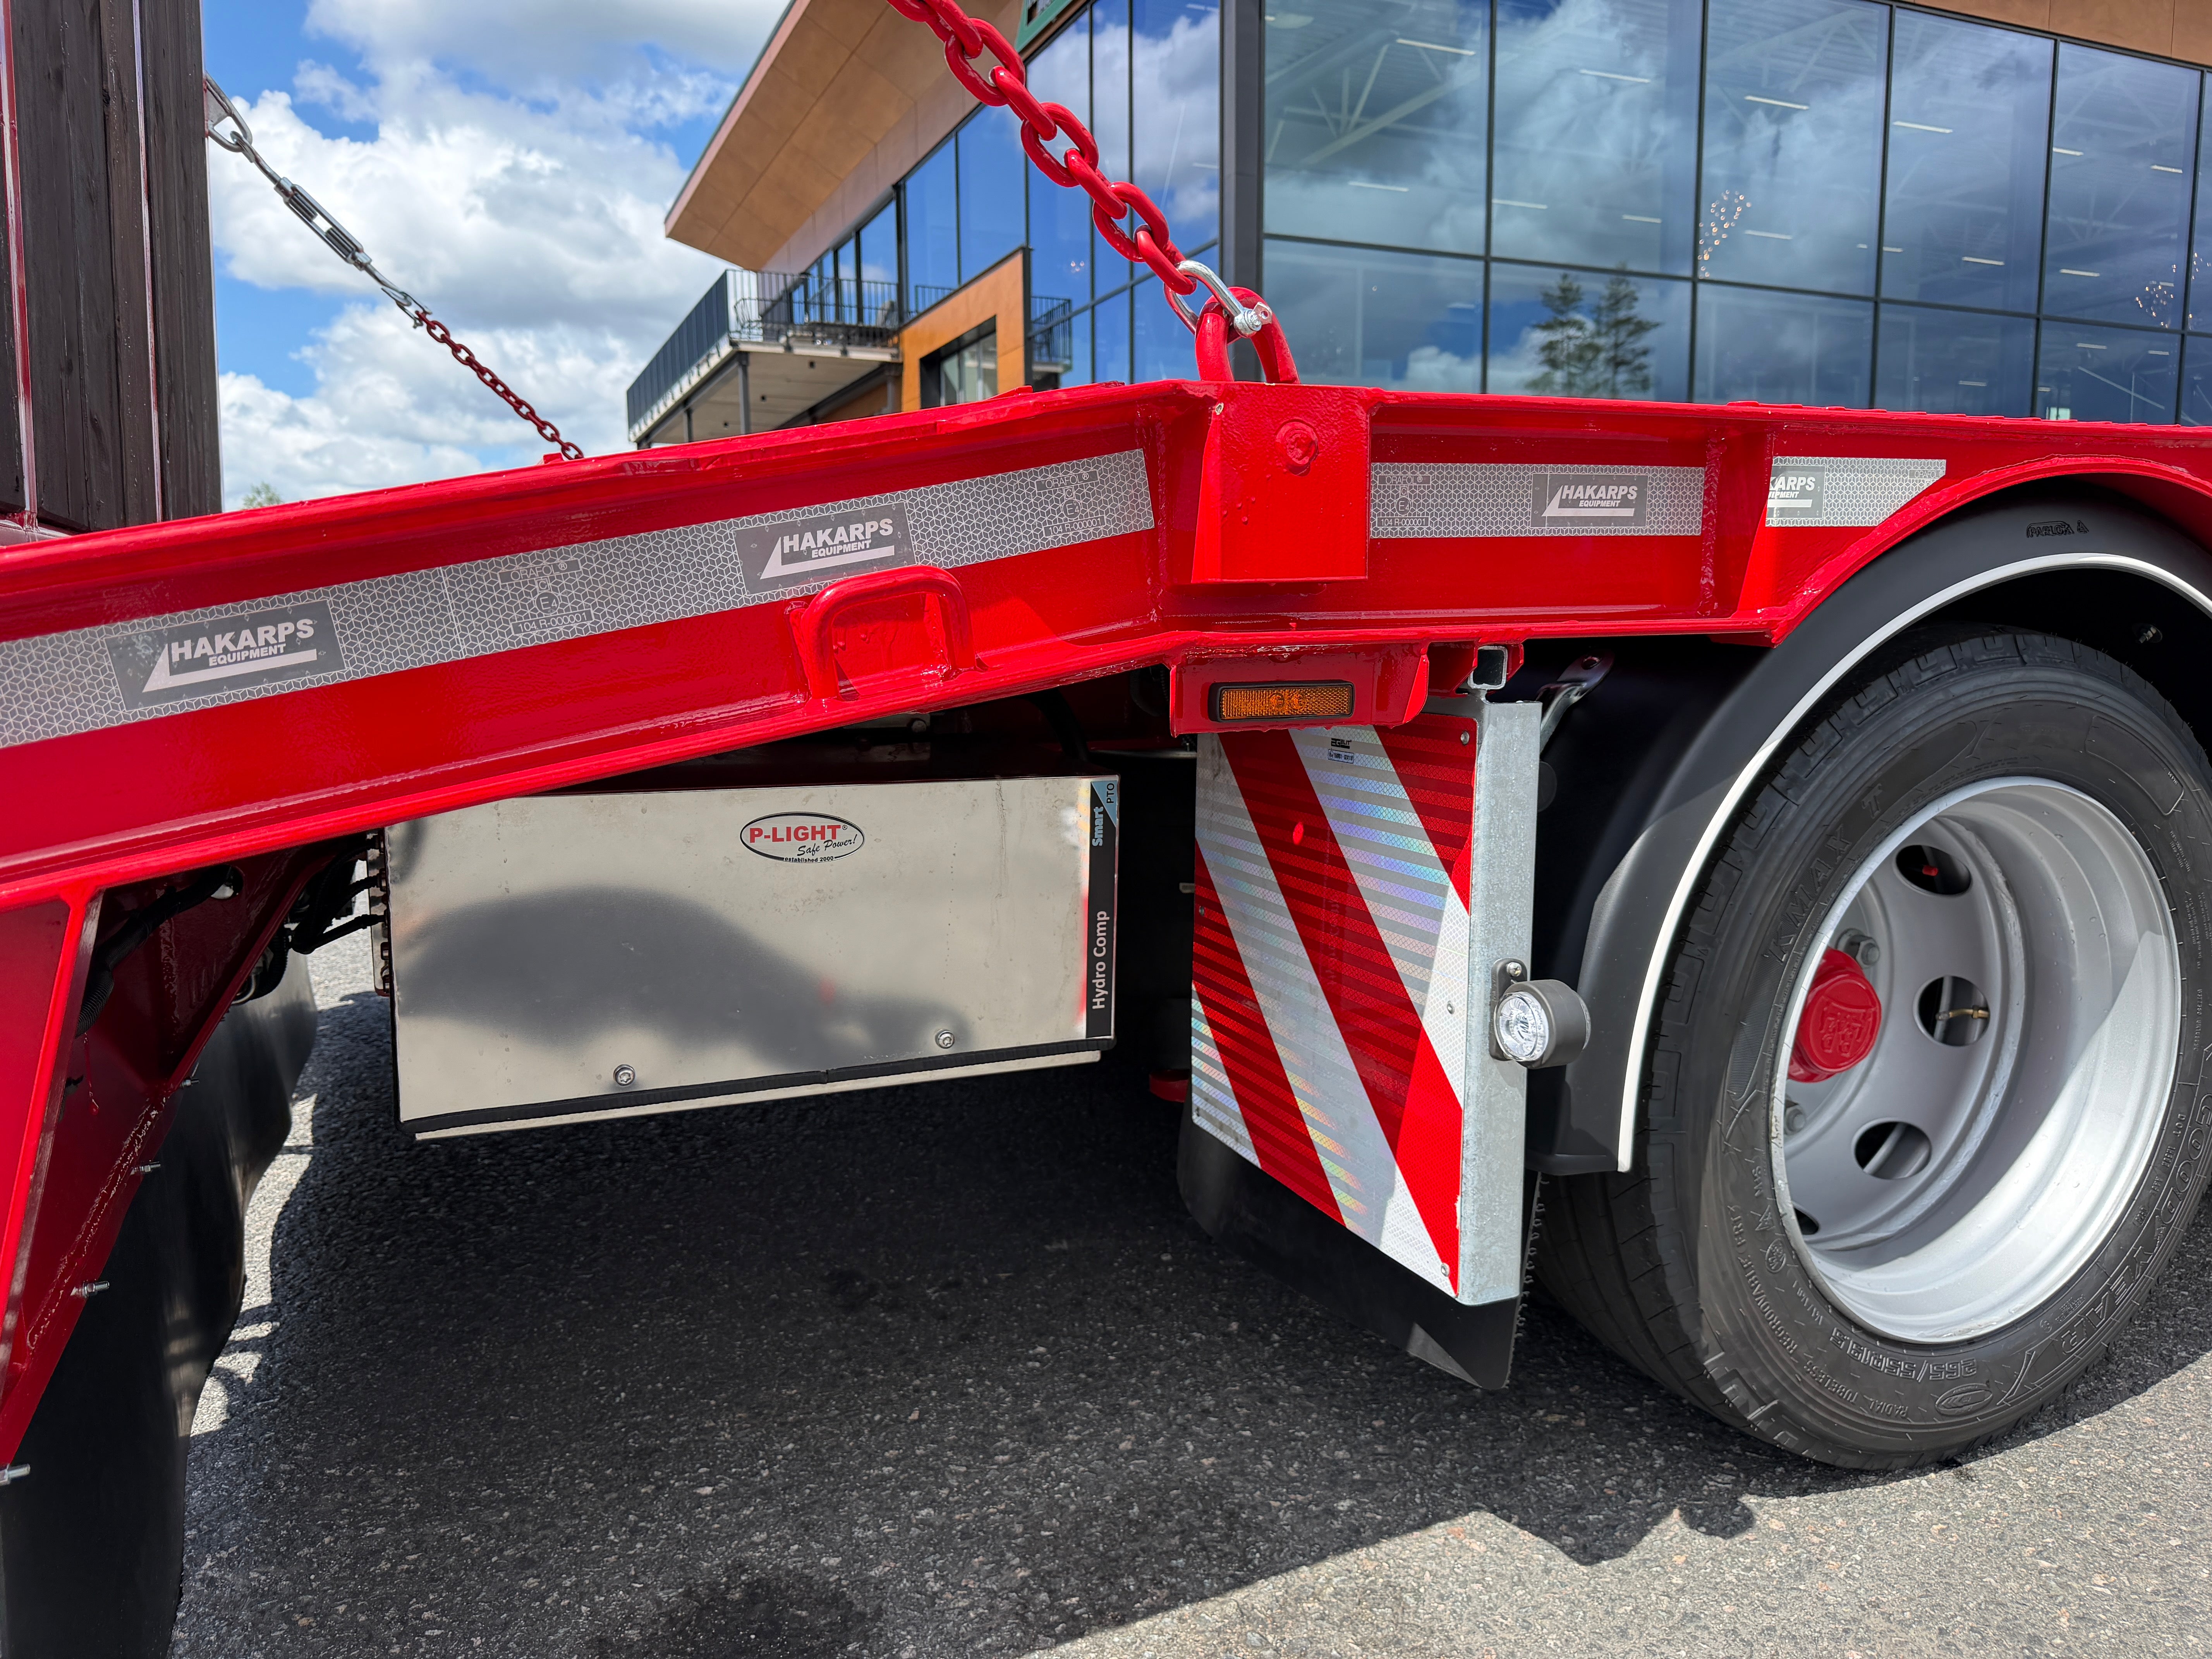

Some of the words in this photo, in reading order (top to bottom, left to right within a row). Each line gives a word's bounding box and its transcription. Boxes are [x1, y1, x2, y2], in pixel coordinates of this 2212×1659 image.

[1562, 486, 1637, 500] HAKARPS
[783, 519, 893, 553] HAKARPS
[1065, 518, 1101, 531] R-000001
[812, 540, 871, 558] EQUIPMENT
[519, 622, 537, 632] 104
[539, 612, 587, 628] R-000001
[172, 619, 314, 661] HAKARPS
[209, 644, 286, 666] EQUIPMENT
[1106, 783, 1115, 804] PTO
[1092, 806, 1103, 847] Smart
[797, 845, 820, 856] Safe
[823, 834, 857, 851] Power!
[1093, 911, 1109, 957] Comp
[1092, 962, 1108, 1010] Hydro
[1736, 1255, 1798, 1354] REGROOVABLE
[1829, 1327, 1977, 1382] 265/55R19.5
[1803, 1360, 1858, 1405] TUBELESS
[1869, 1397, 1909, 1417] RADIAL
